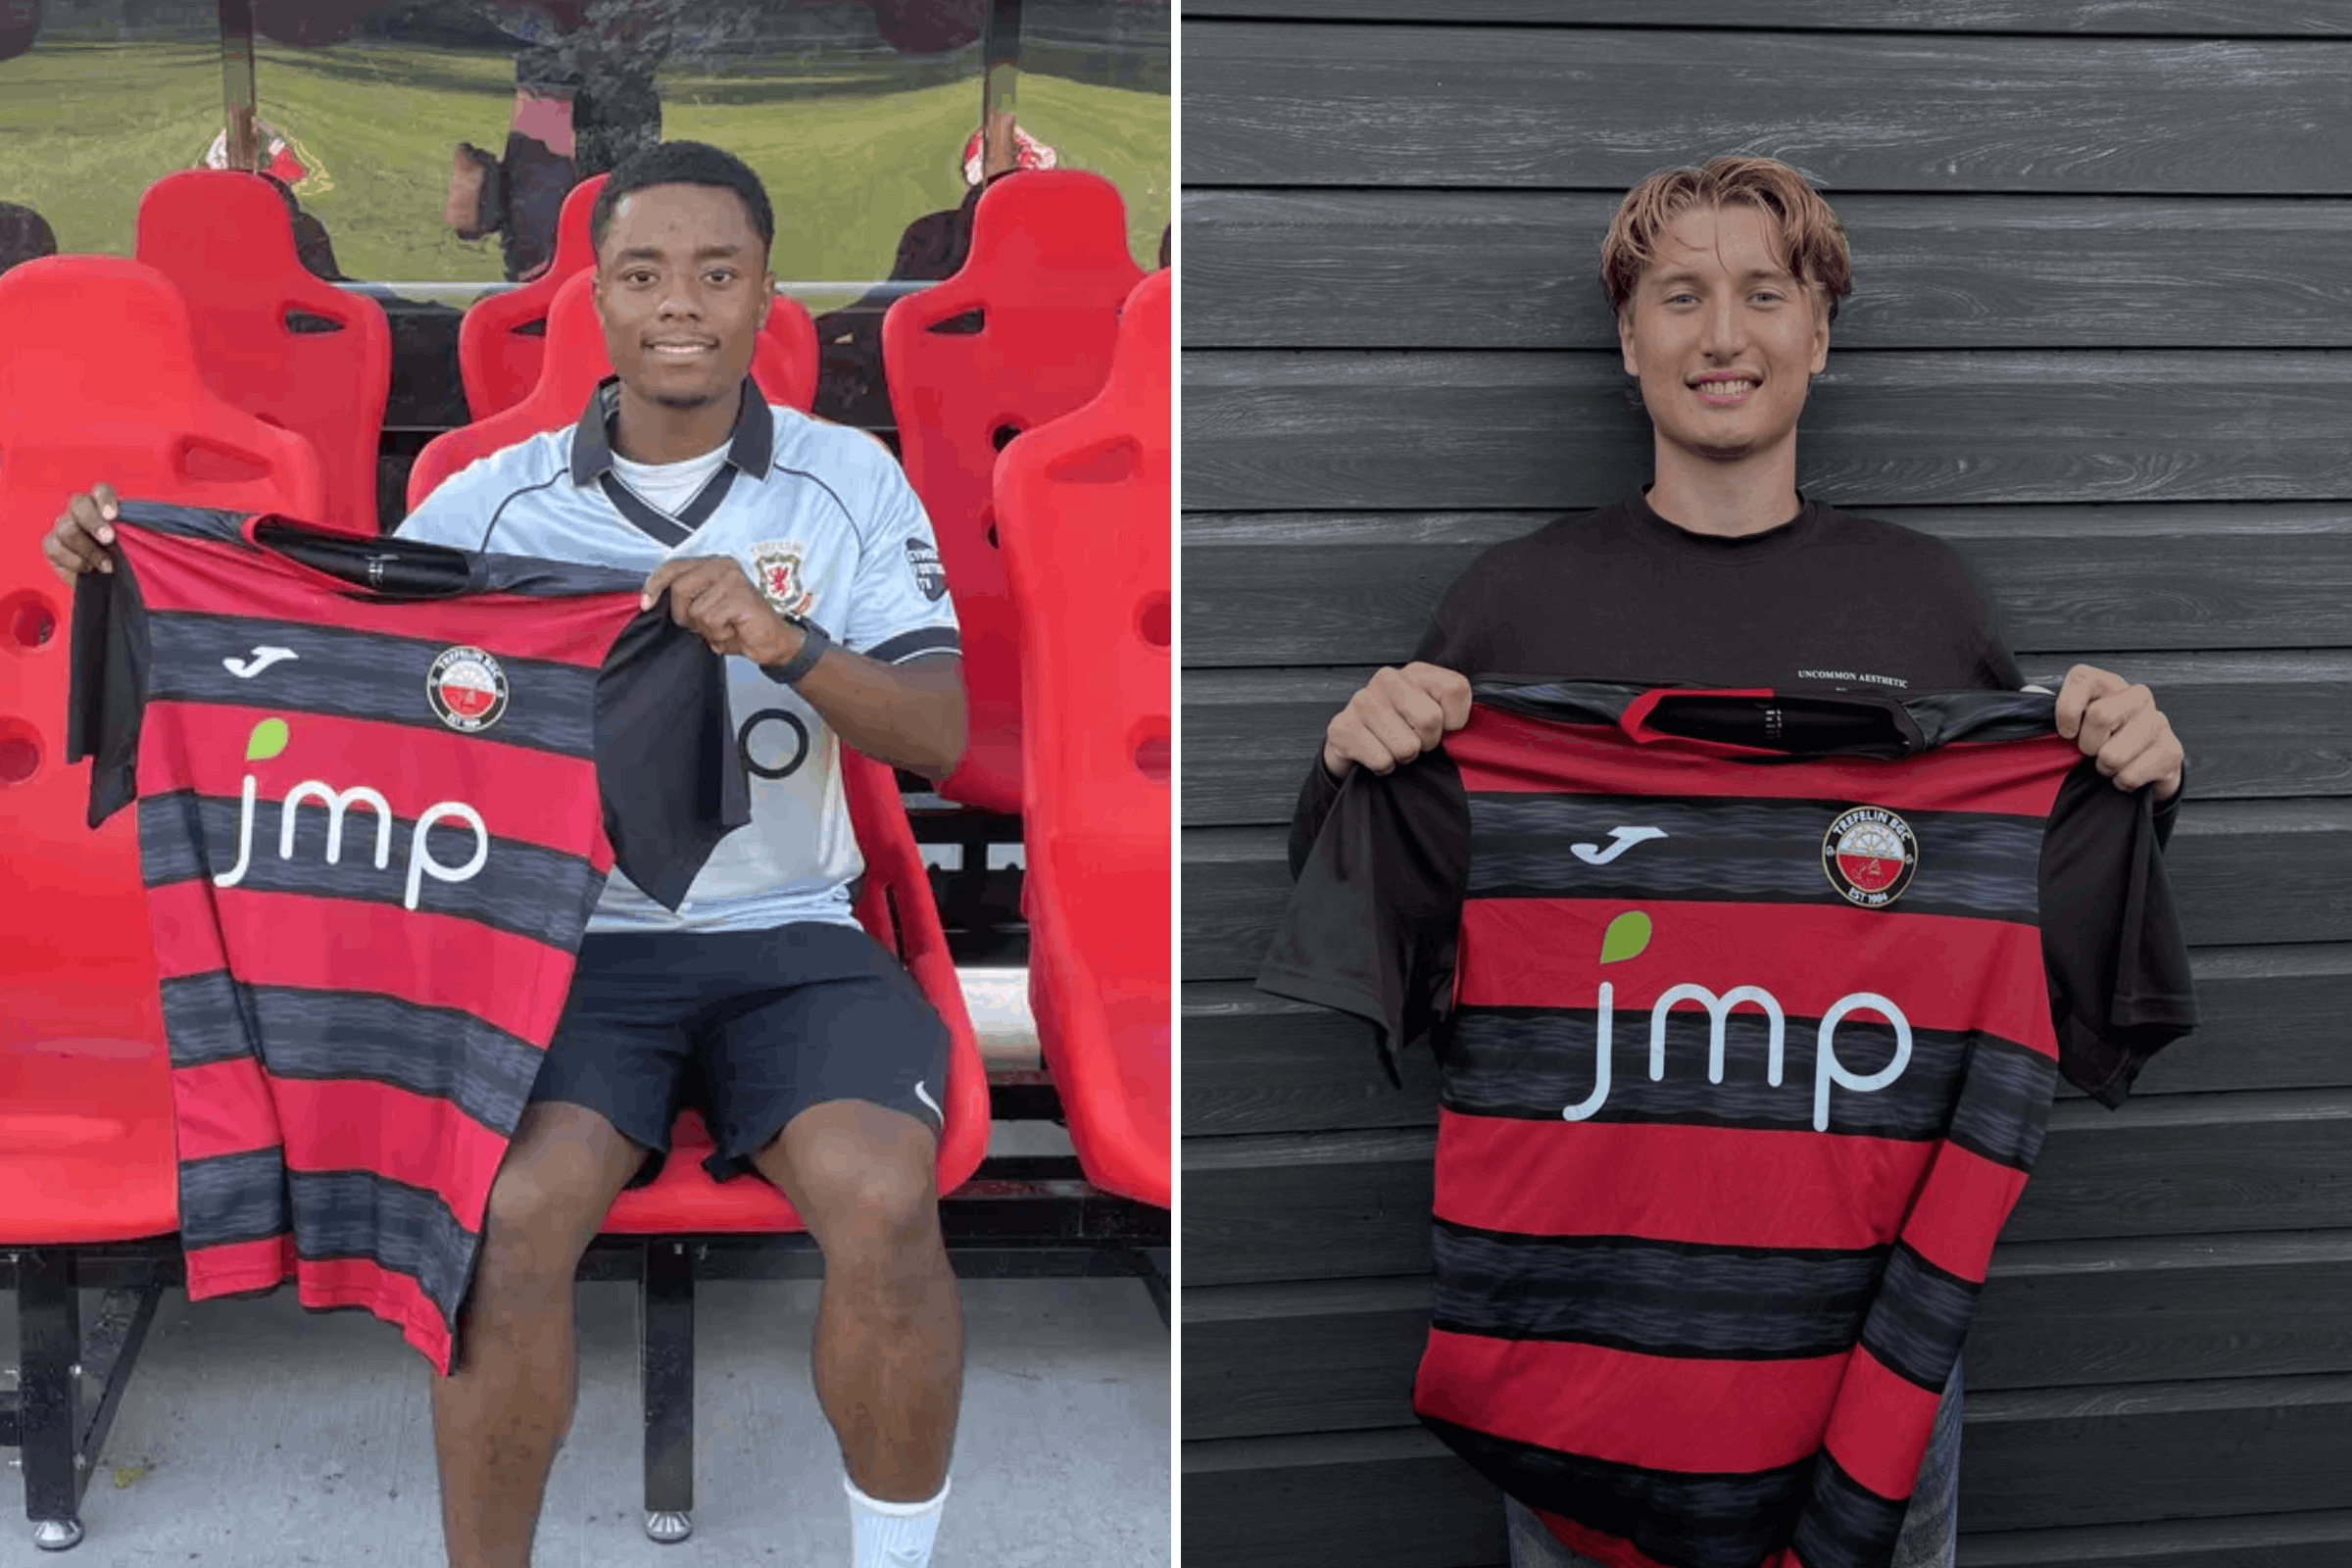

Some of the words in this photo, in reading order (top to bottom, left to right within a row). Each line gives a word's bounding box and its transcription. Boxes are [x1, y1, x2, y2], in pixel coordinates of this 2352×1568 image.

[1797, 669, 1856, 681] UNCOMMON
[1858, 672, 1909, 689] AESTHETIC
[213, 717, 489, 910] jmp
[1832, 809, 1889, 836] TREFELIN
[1562, 910, 1914, 1133] jmp
